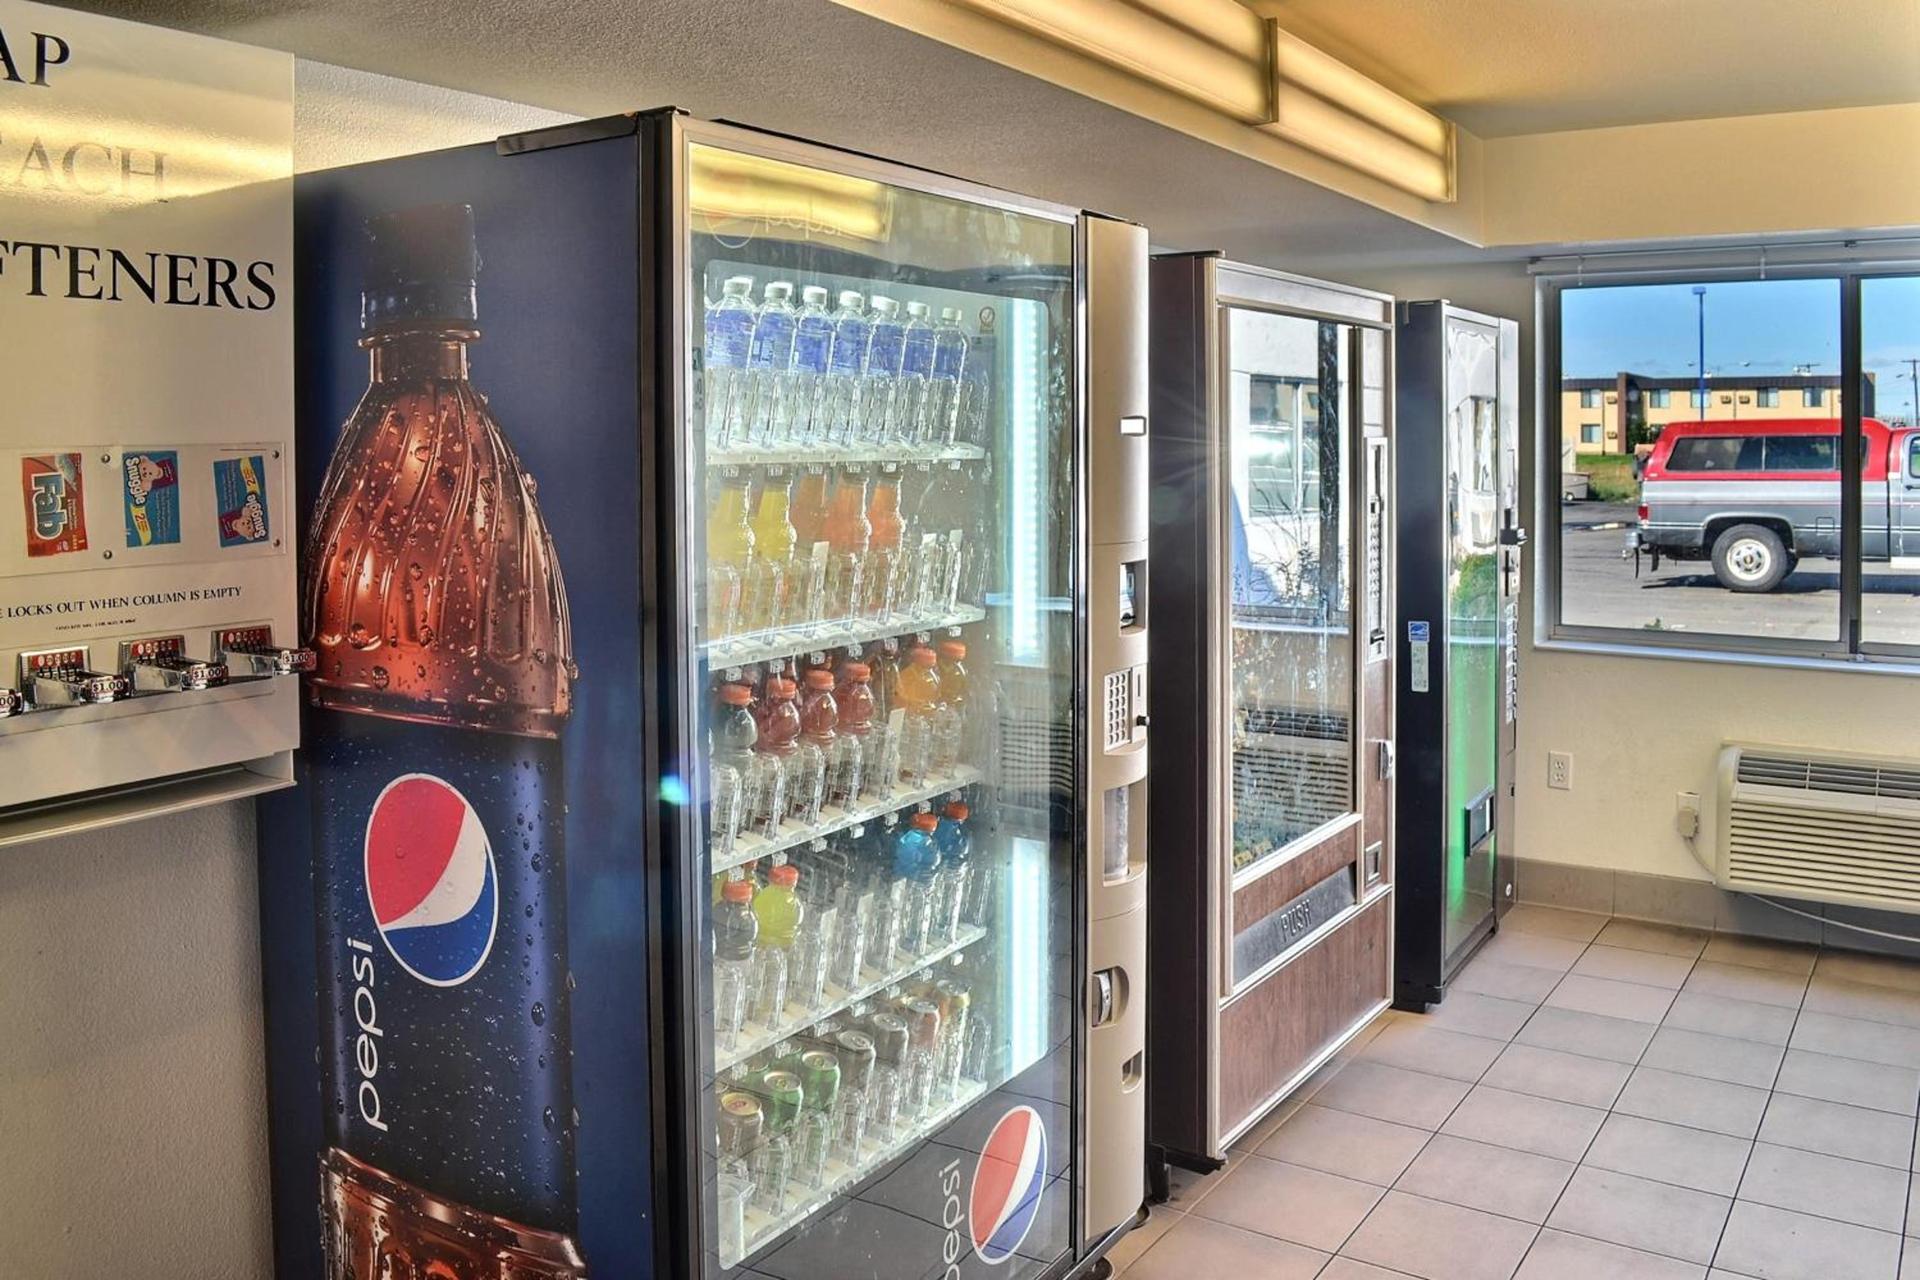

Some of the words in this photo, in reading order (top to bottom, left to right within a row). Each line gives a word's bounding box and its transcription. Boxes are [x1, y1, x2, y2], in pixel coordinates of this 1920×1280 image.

[126, 456, 149, 505] Snuggle
[31, 472, 67, 540] Fab
[246, 494, 267, 539] Snuggle
[8, 603, 53, 618] LOCKS
[57, 601, 86, 614] OUT
[89, 597, 129, 610] WHEN
[133, 592, 187, 607] COLUMN
[190, 590, 200, 601] IS
[203, 586, 242, 600] EMPTY
[92, 680, 123, 692] $1.00
[1280, 899, 1312, 943] PUSH
[347, 937, 389, 1132] pepsi
